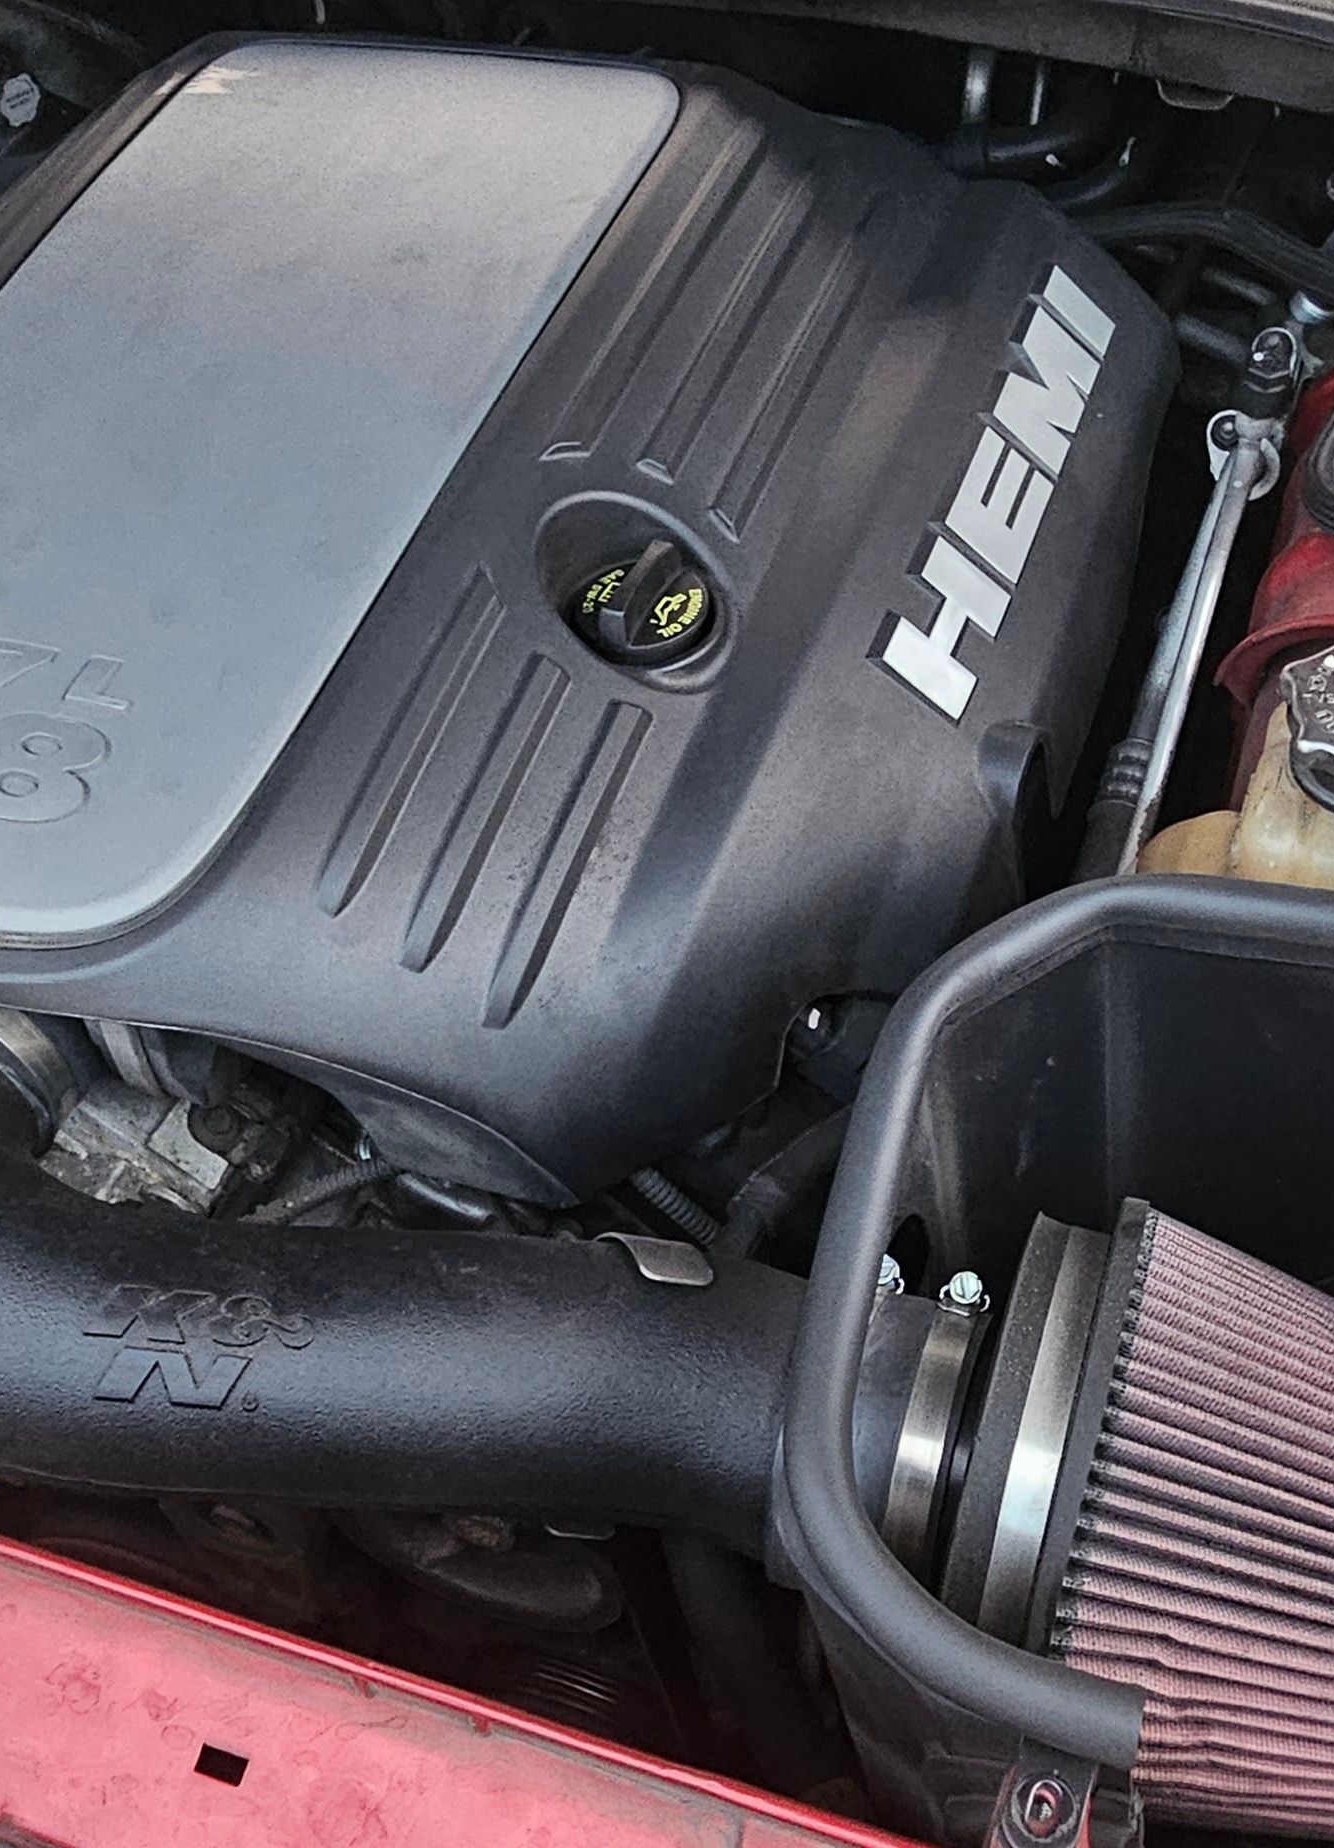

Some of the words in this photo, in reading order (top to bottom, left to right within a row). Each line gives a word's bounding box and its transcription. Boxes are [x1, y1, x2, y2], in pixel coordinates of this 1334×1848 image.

[870, 264, 1117, 722] HEMI
[677, 589, 703, 625] ENGINE
[655, 622, 683, 638] OIL
